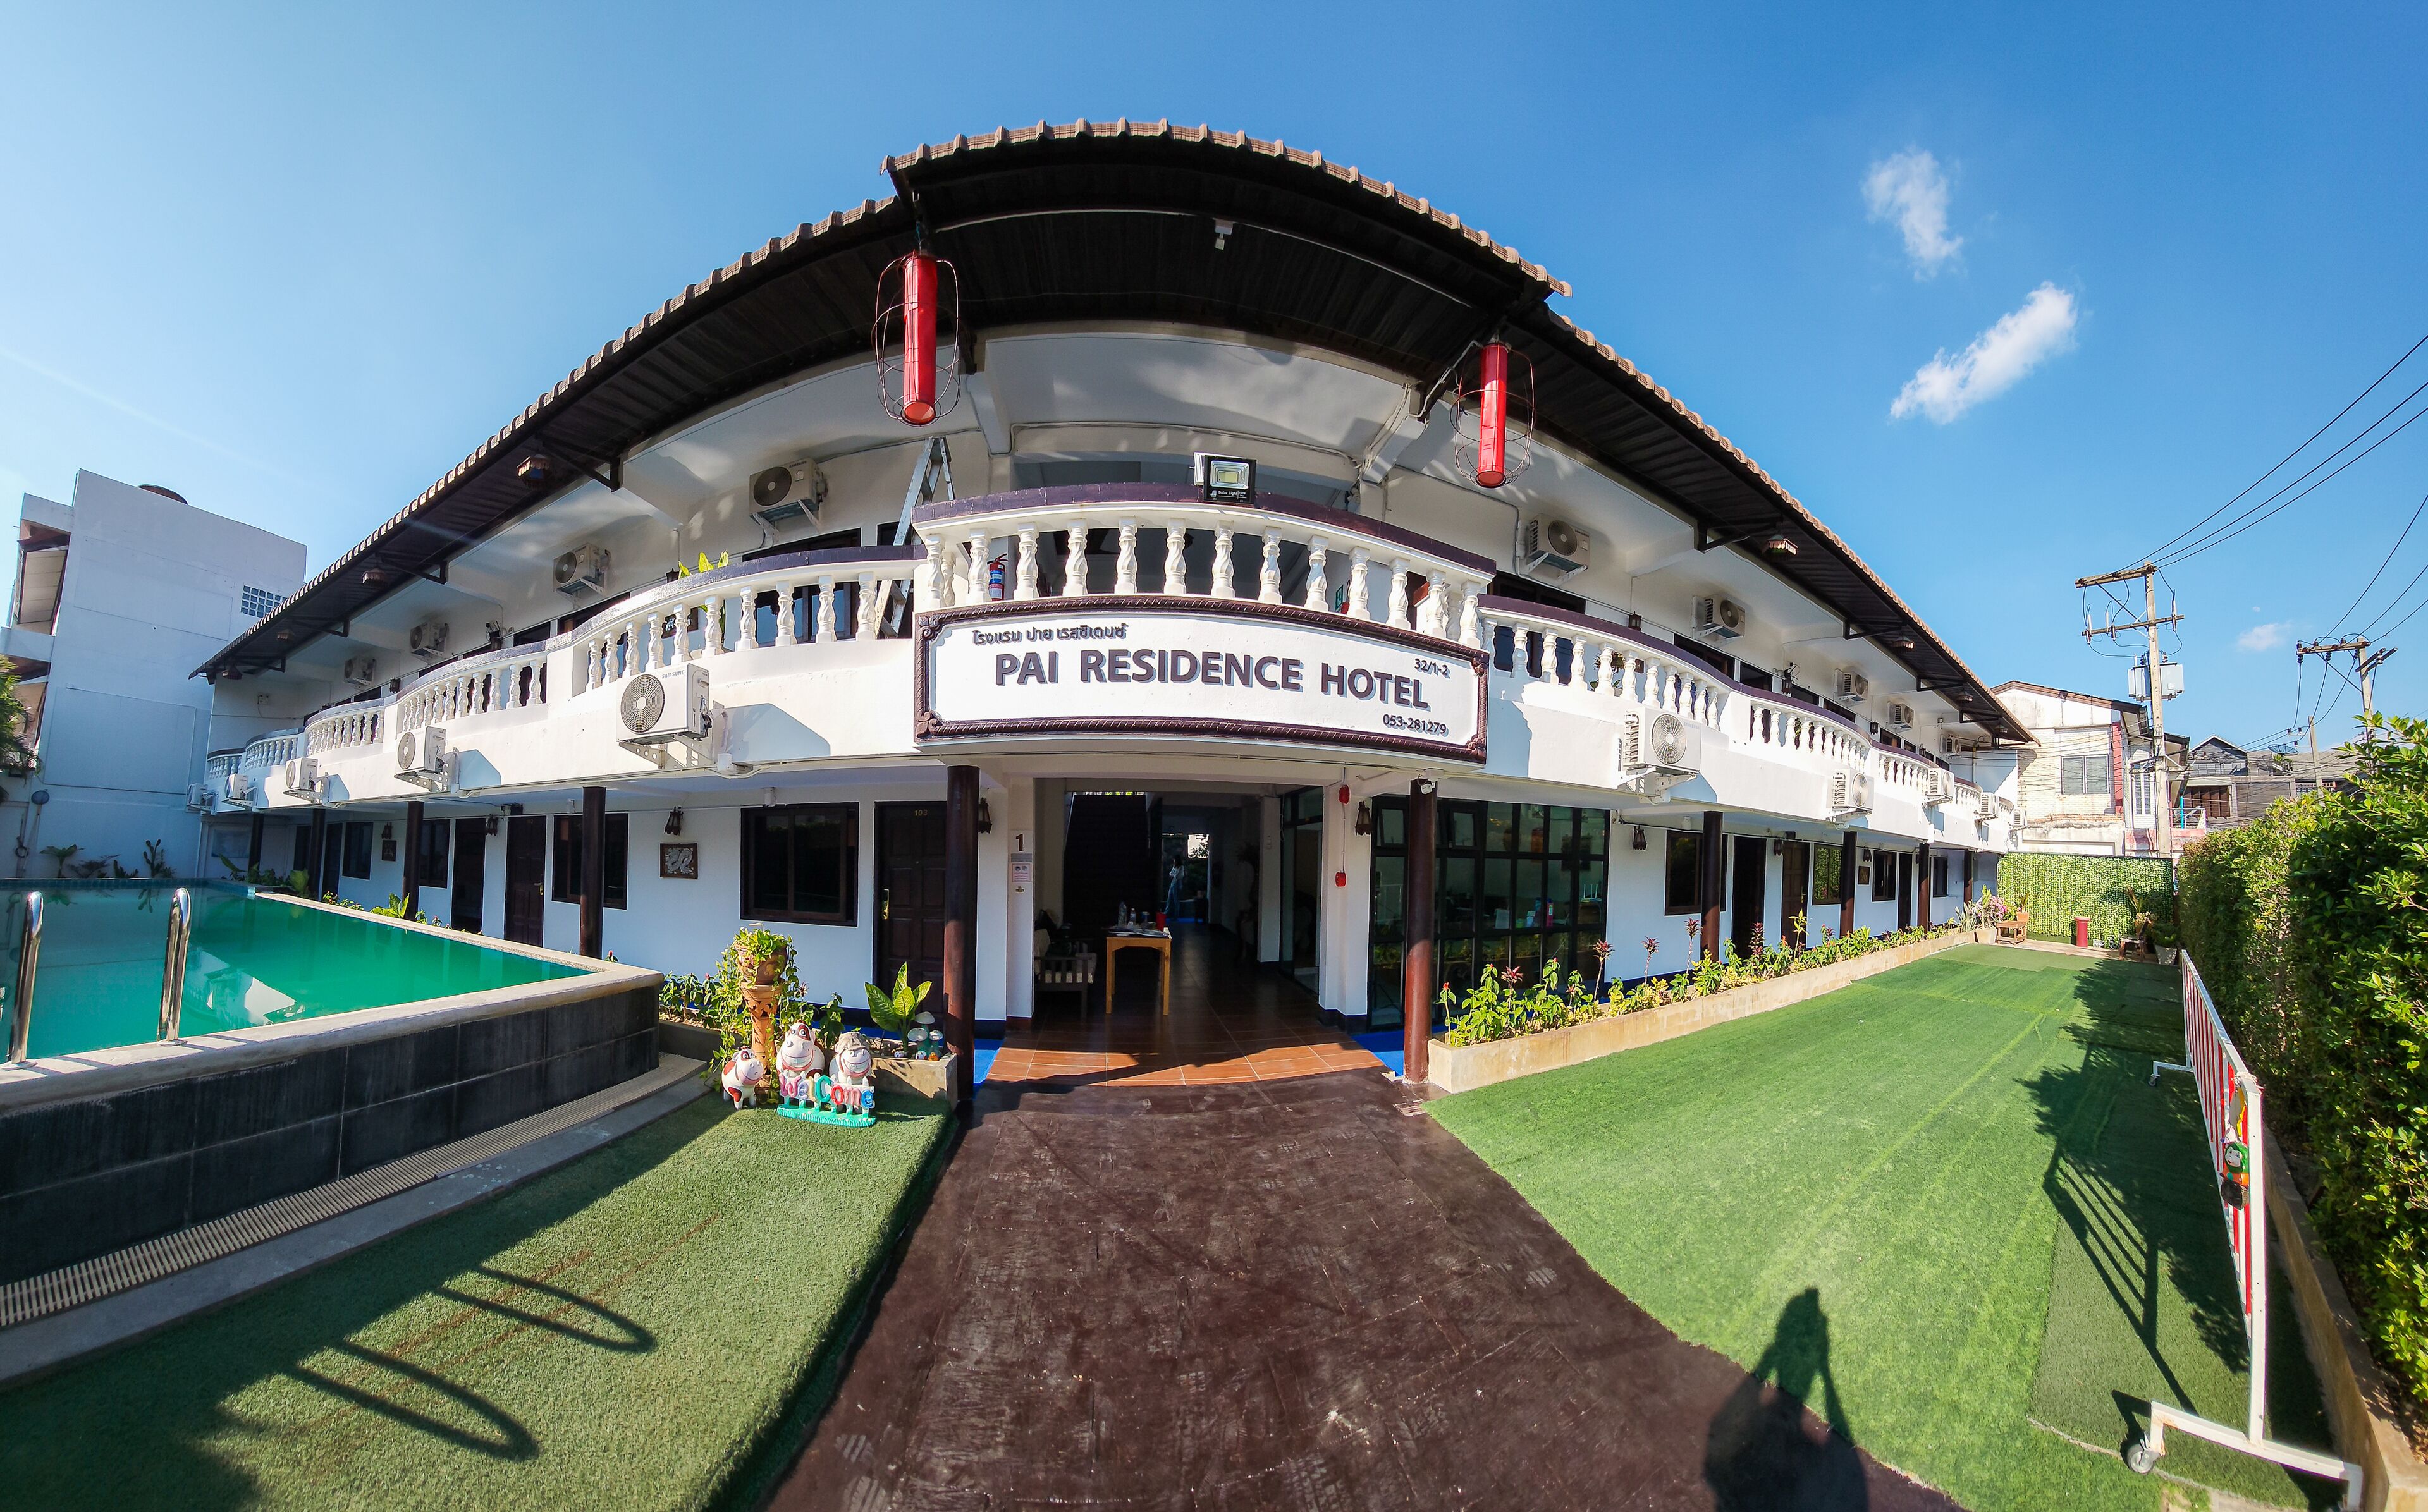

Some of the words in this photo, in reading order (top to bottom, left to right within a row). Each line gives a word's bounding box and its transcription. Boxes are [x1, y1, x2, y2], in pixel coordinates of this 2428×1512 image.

[972, 629, 1022, 645] โรงแรม
[1026, 626, 1054, 642] ปาย
[661, 669, 685, 679] SAMSUNG
[1414, 657, 1450, 679] 32/1-2
[995, 650, 1058, 687] PAI
[1080, 649, 1304, 693] RESIDENCE
[1320, 662, 1431, 712] HOTEL
[1382, 714, 1449, 737] 053-281279
[1015, 834, 1024, 851] 1
